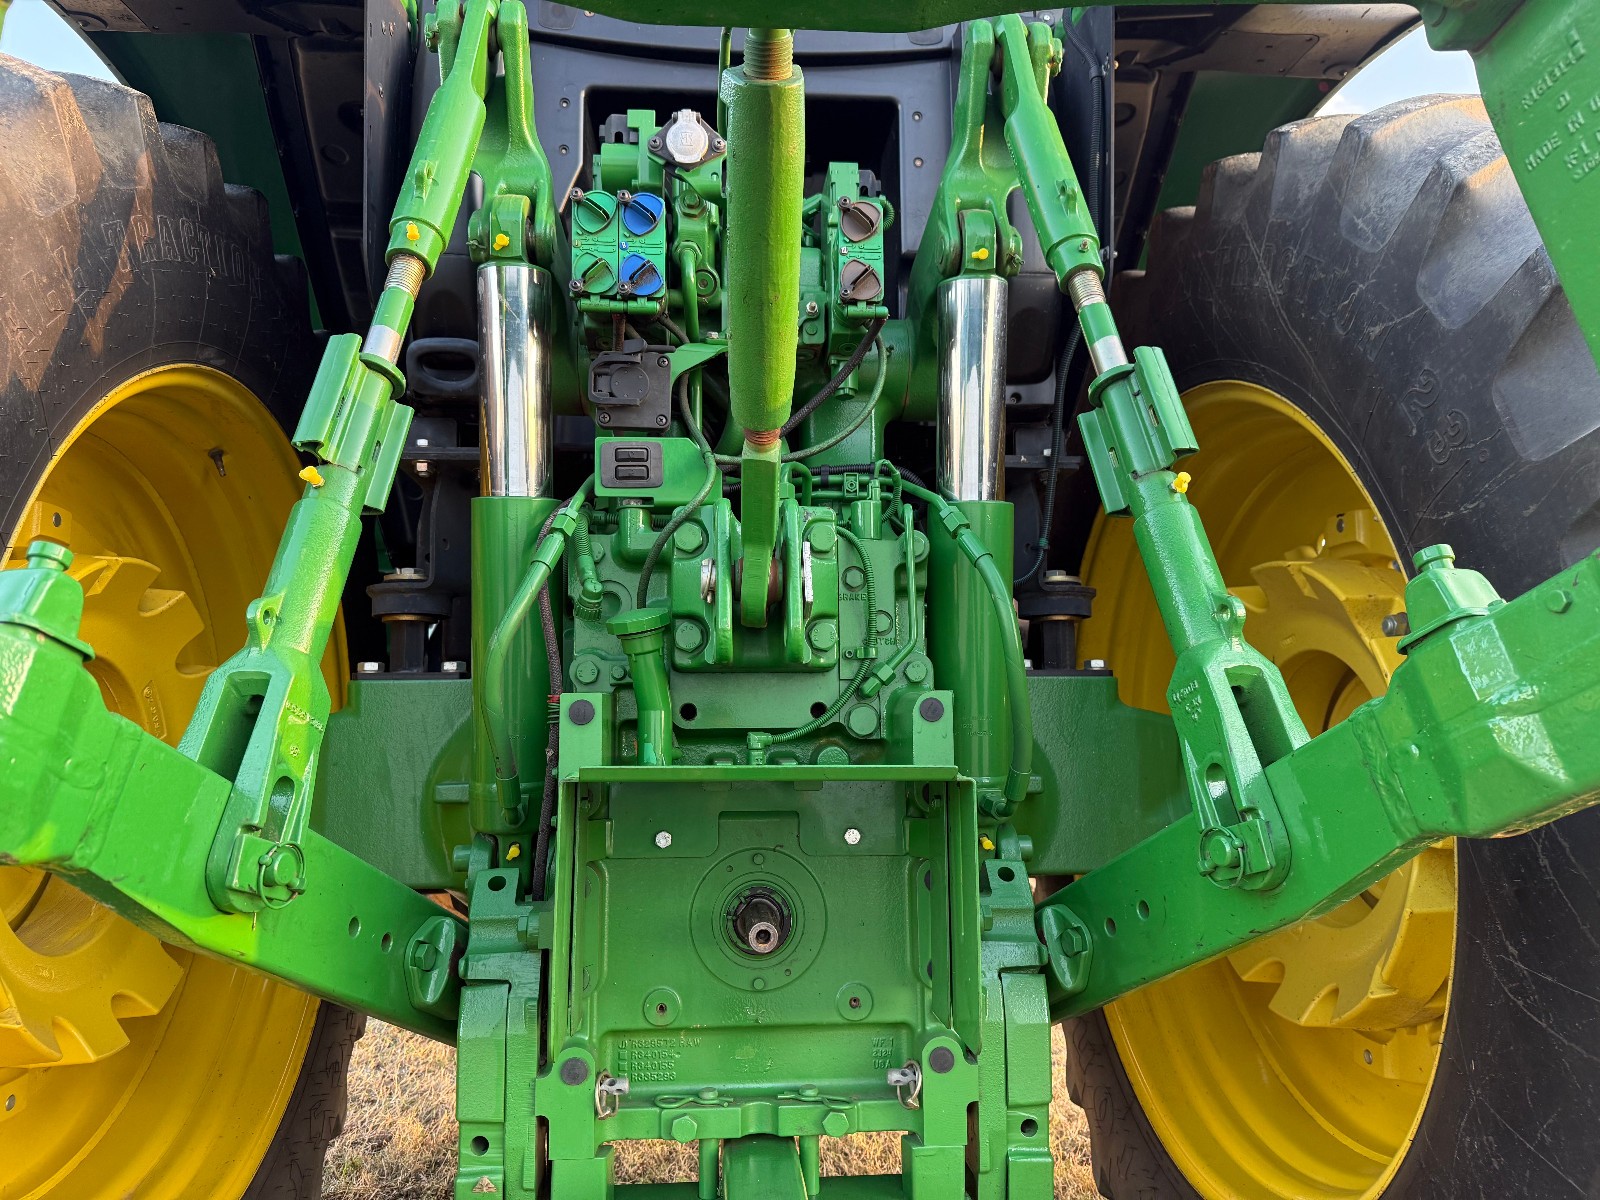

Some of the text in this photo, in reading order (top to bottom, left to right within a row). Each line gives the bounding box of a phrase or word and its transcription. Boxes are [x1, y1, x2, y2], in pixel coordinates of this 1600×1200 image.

[1525, 131, 1563, 172] MADE
[1567, 111, 1586, 134] IN
[100, 214, 263, 302] TRACTION
[679, 1037, 702, 1048] RAW
[872, 1059, 893, 1069] USA
